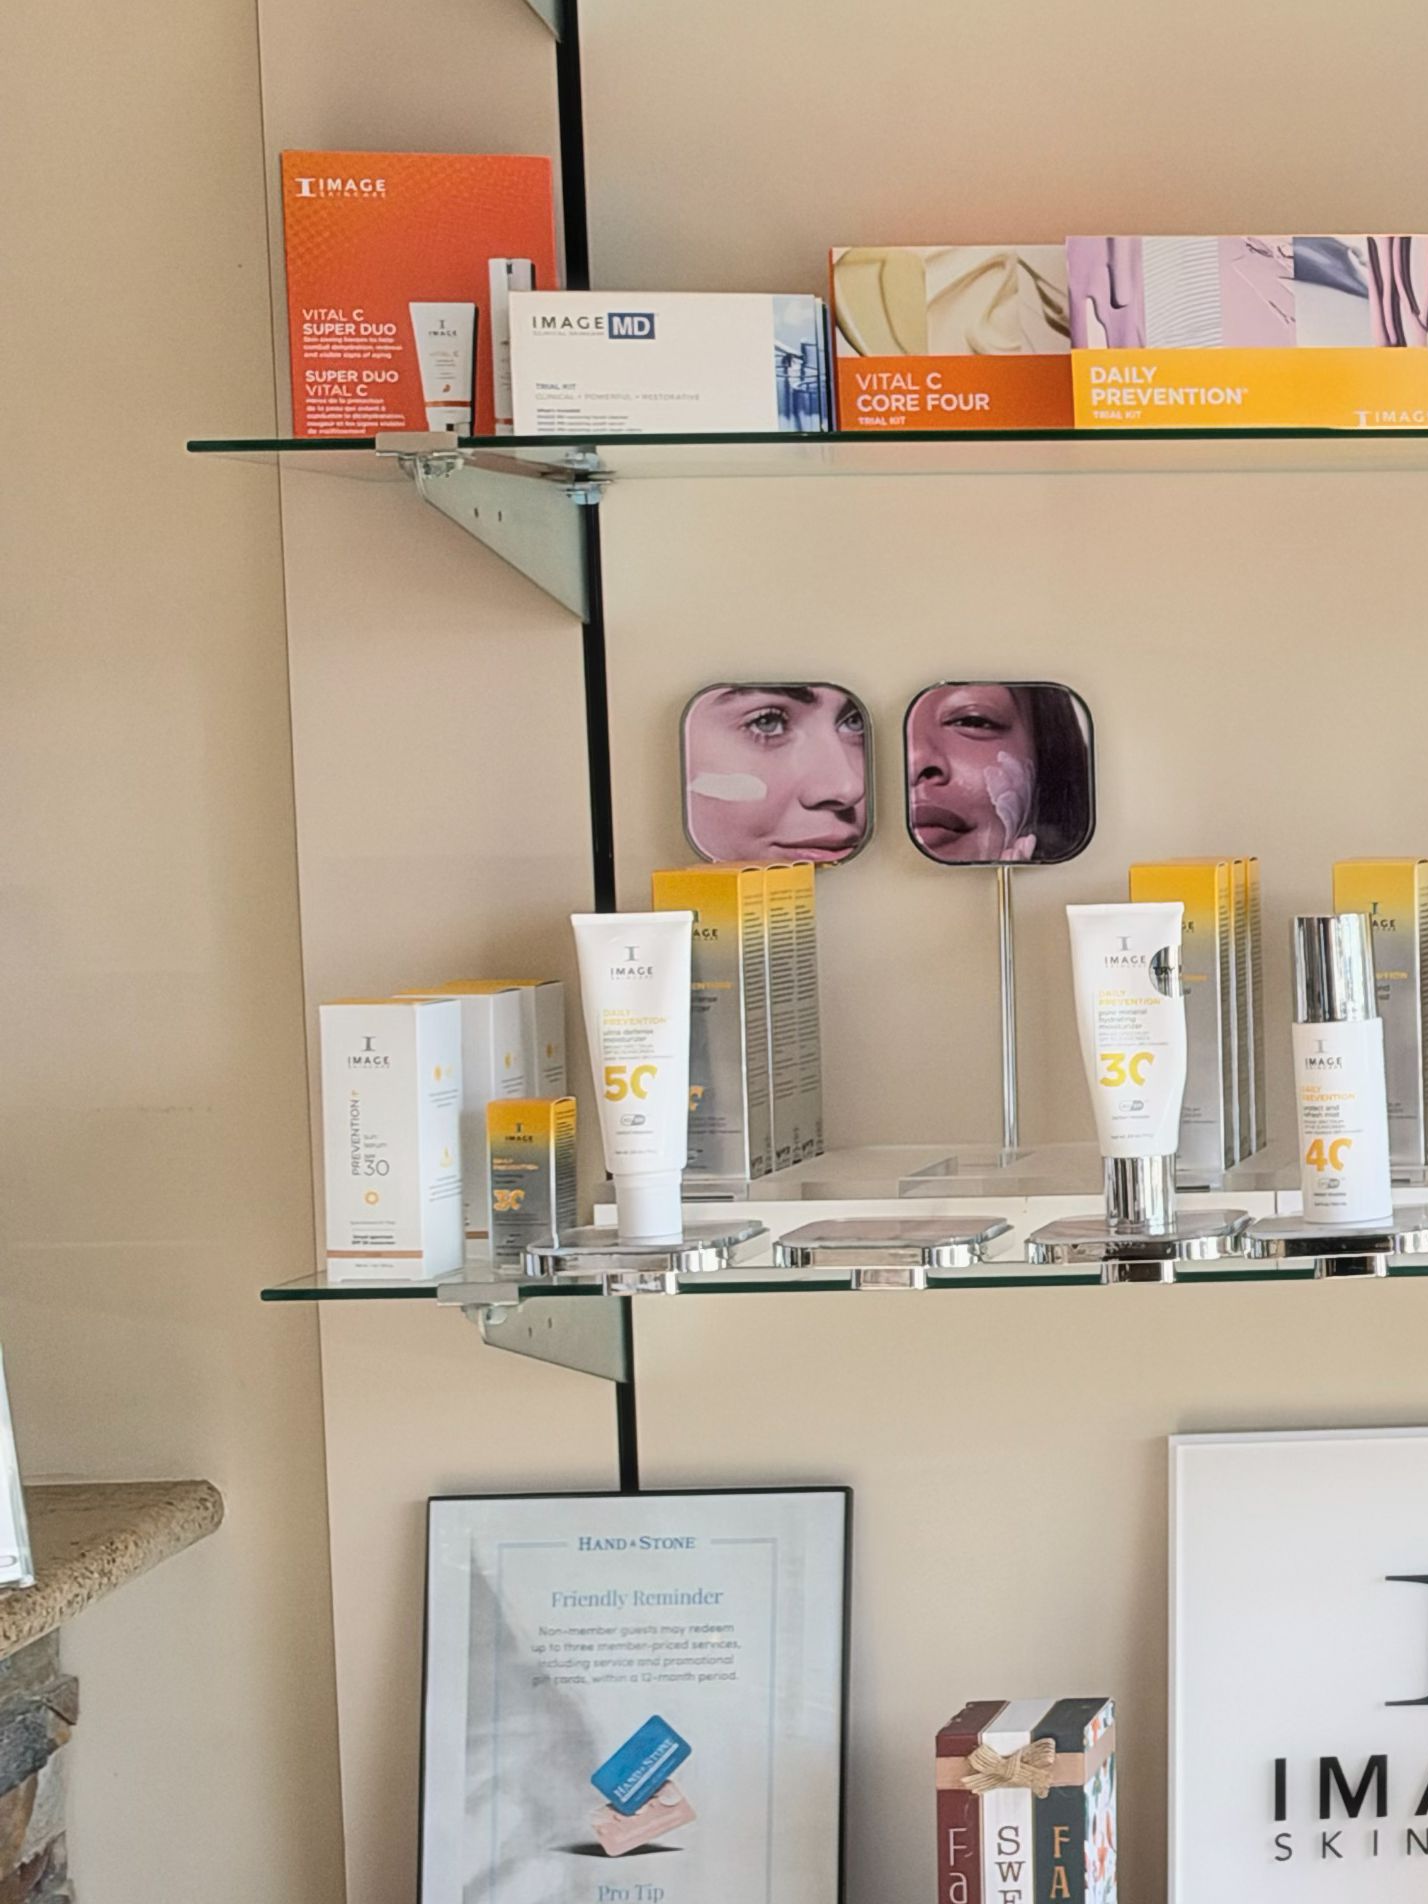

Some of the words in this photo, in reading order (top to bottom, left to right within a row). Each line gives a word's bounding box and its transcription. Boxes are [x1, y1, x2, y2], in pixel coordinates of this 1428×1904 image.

[318, 178, 386, 192] IMAGE
[302, 308, 348, 322] VITAL
[352, 308, 364, 322] C
[302, 323, 357, 336] SUPER
[360, 323, 396, 336] DUO
[532, 315, 605, 330] IMAGE
[612, 316, 651, 337] MD
[855, 371, 914, 391] VITAL
[925, 372, 942, 391] C
[1089, 366, 1157, 387] DAILY
[856, 393, 921, 413] CORE
[926, 392, 991, 412] FOUR
[1090, 386, 1243, 407] PREVENTION
[610, 966, 654, 976] IMAGE
[1103, 955, 1147, 967] IMAGE
[1098, 1051, 1156, 1088] 30
[604, 1064, 658, 1103] 50
[1304, 1137, 1353, 1174] 40
[364, 1159, 390, 1177] 30
[578, 1536, 627, 1551] HAND
[639, 1536, 696, 1550] STONE
[551, 1590, 628, 1610] Friendly
[633, 1587, 724, 1607] Reminder
[598, 1884, 630, 1902] Pro
[635, 1882, 665, 1903] Tip
